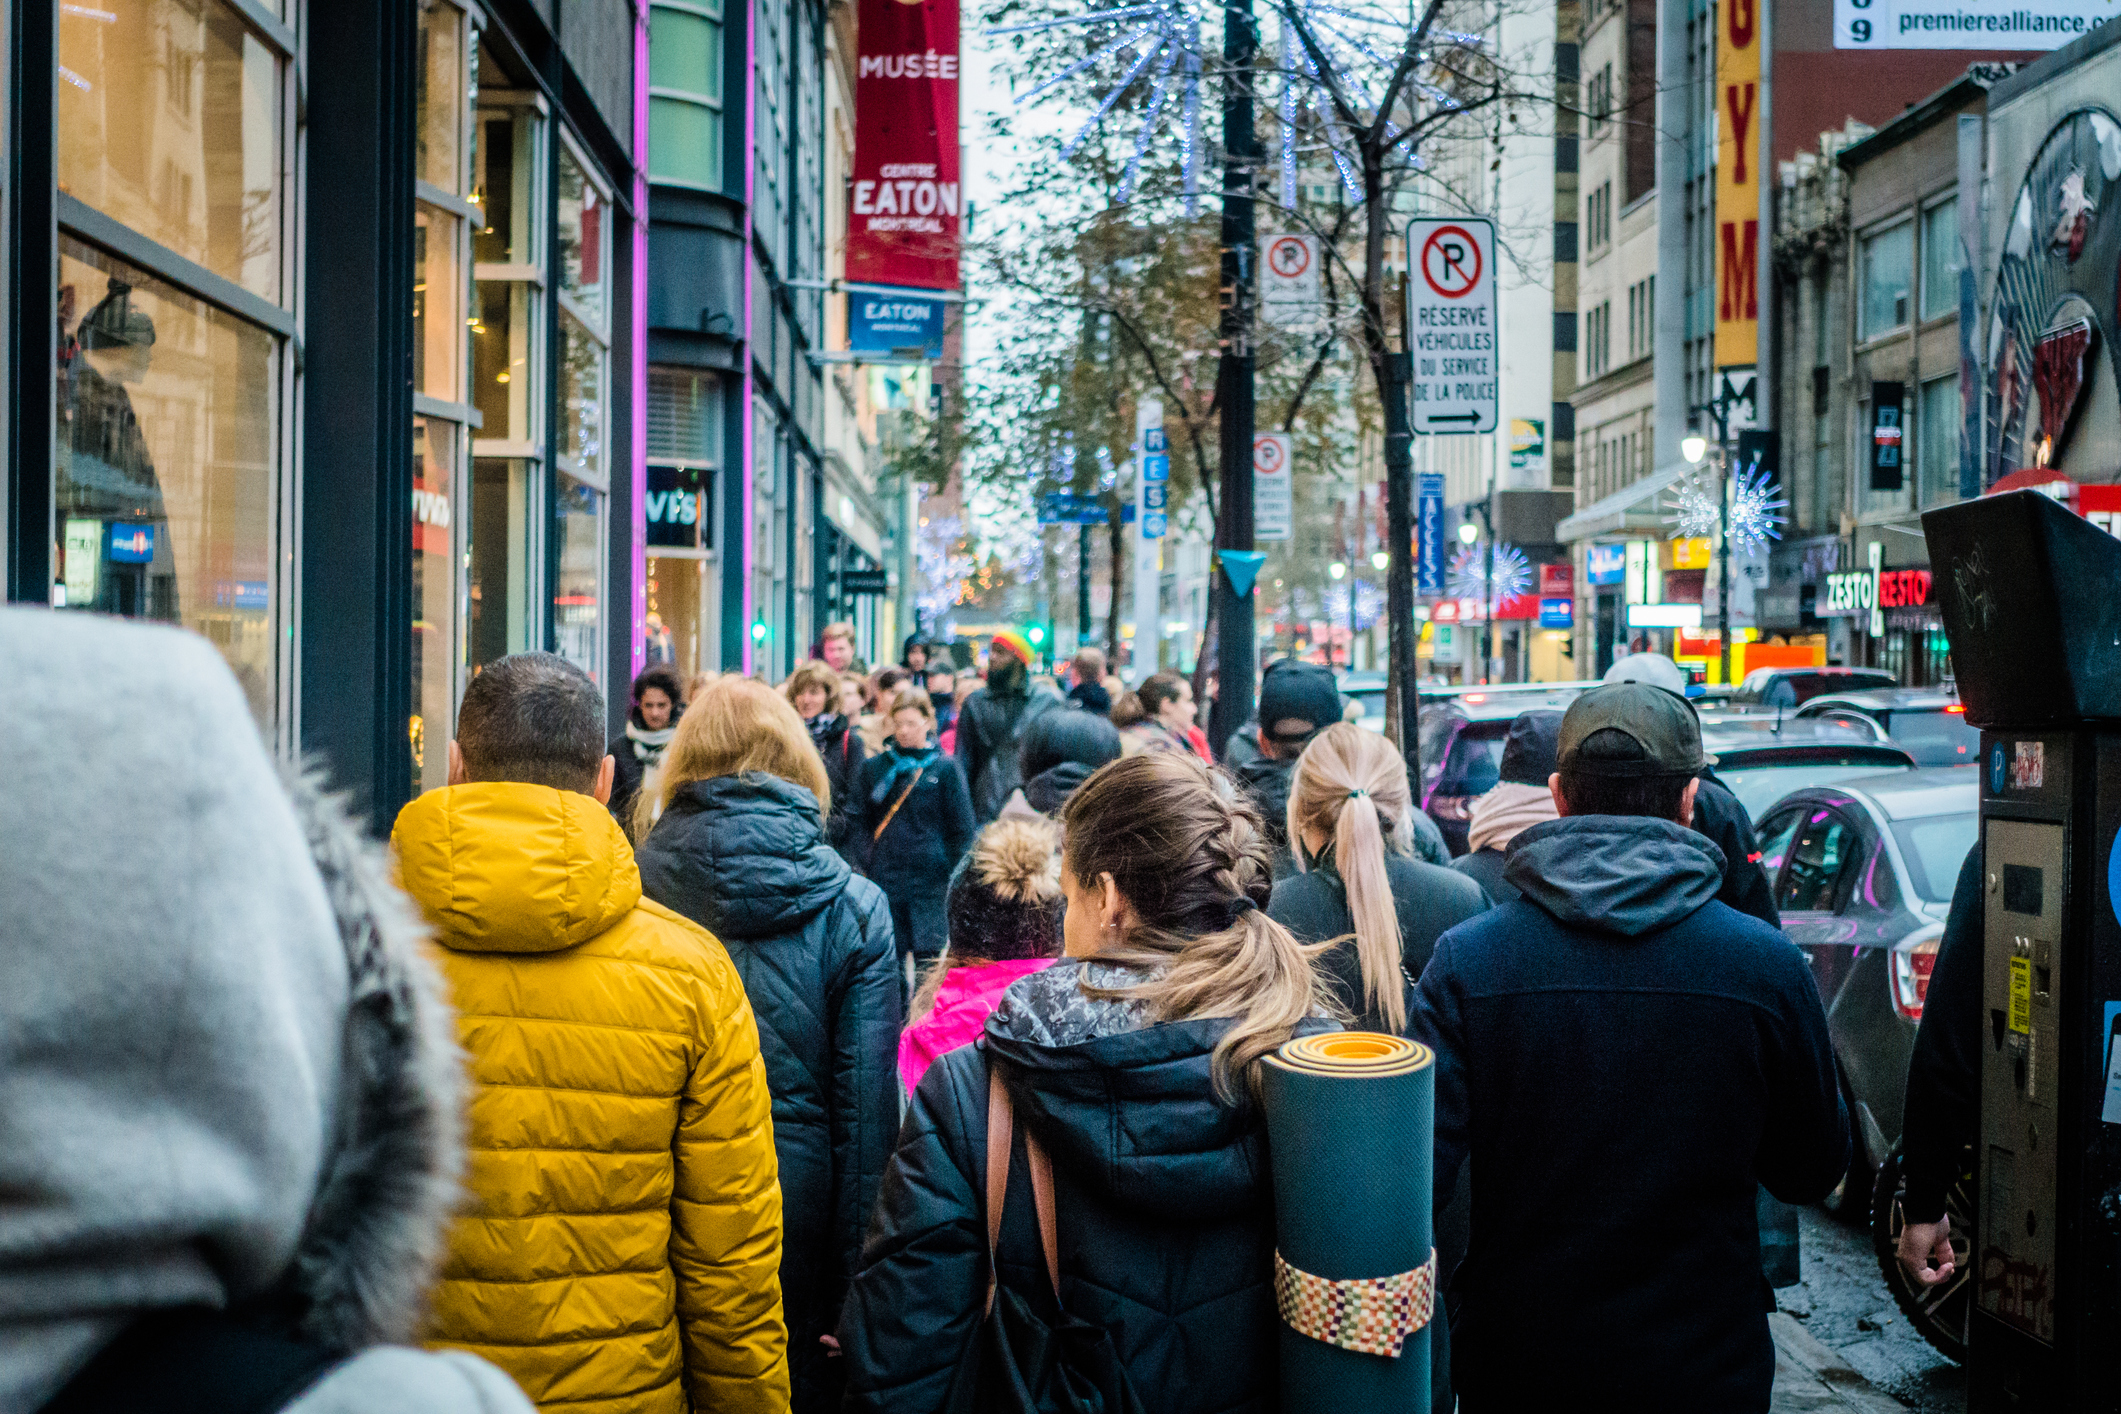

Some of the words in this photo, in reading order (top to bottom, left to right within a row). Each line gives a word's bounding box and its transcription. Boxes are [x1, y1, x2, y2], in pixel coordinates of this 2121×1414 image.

[860, 48, 958, 79] MUSÉE
[880, 163, 937, 178] CENTRE
[854, 180, 958, 216] EATON
[864, 302, 931, 320] EATON
[1419, 305, 1487, 326] RÉSERVÉ
[1417, 331, 1491, 351] VÉHICULES
[1420, 358, 1436, 376] DU
[1442, 358, 1488, 376] SERVICE
[1414, 383, 1428, 401] DE
[1435, 383, 1449, 401] LA
[1456, 382, 1495, 401] POLICE
[1827, 572, 1871, 611] ZESTO
